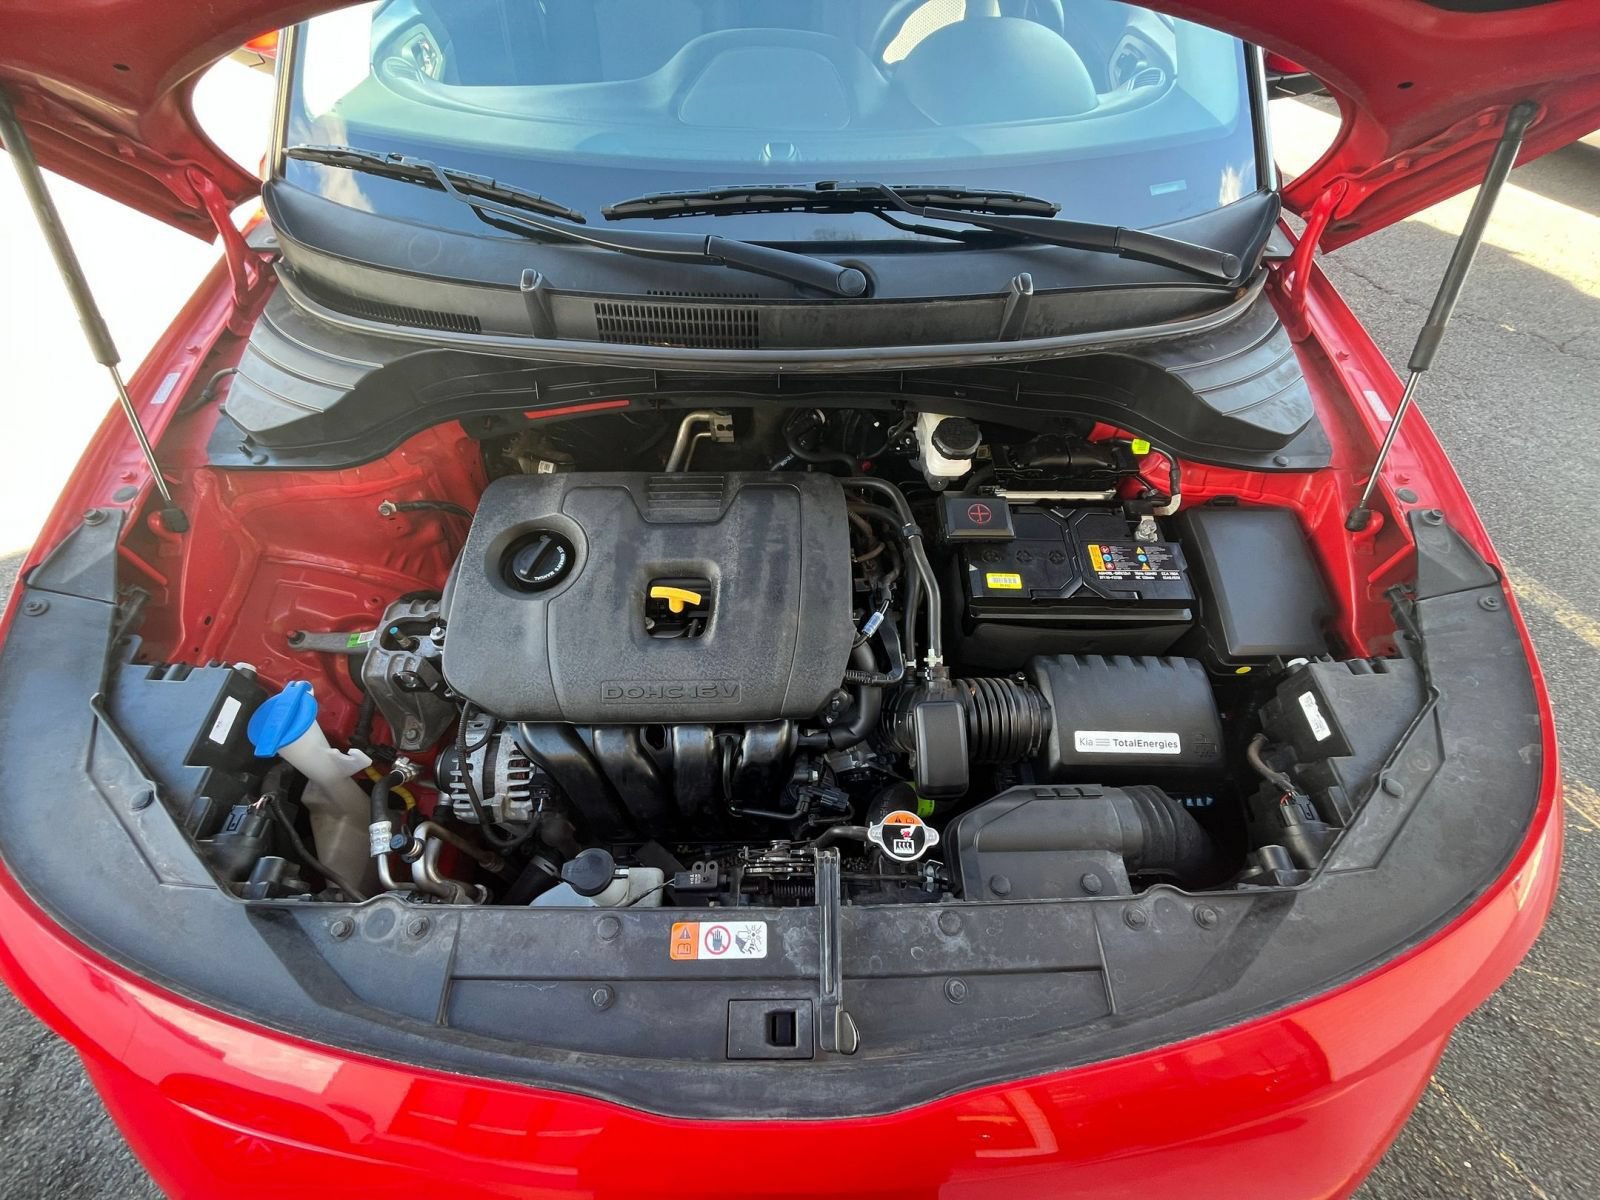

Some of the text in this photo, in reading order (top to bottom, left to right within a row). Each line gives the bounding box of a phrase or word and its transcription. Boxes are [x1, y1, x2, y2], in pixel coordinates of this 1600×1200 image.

[603, 685, 684, 700] DOHC
[1079, 737, 1178, 750] Kia TotalEnergies
